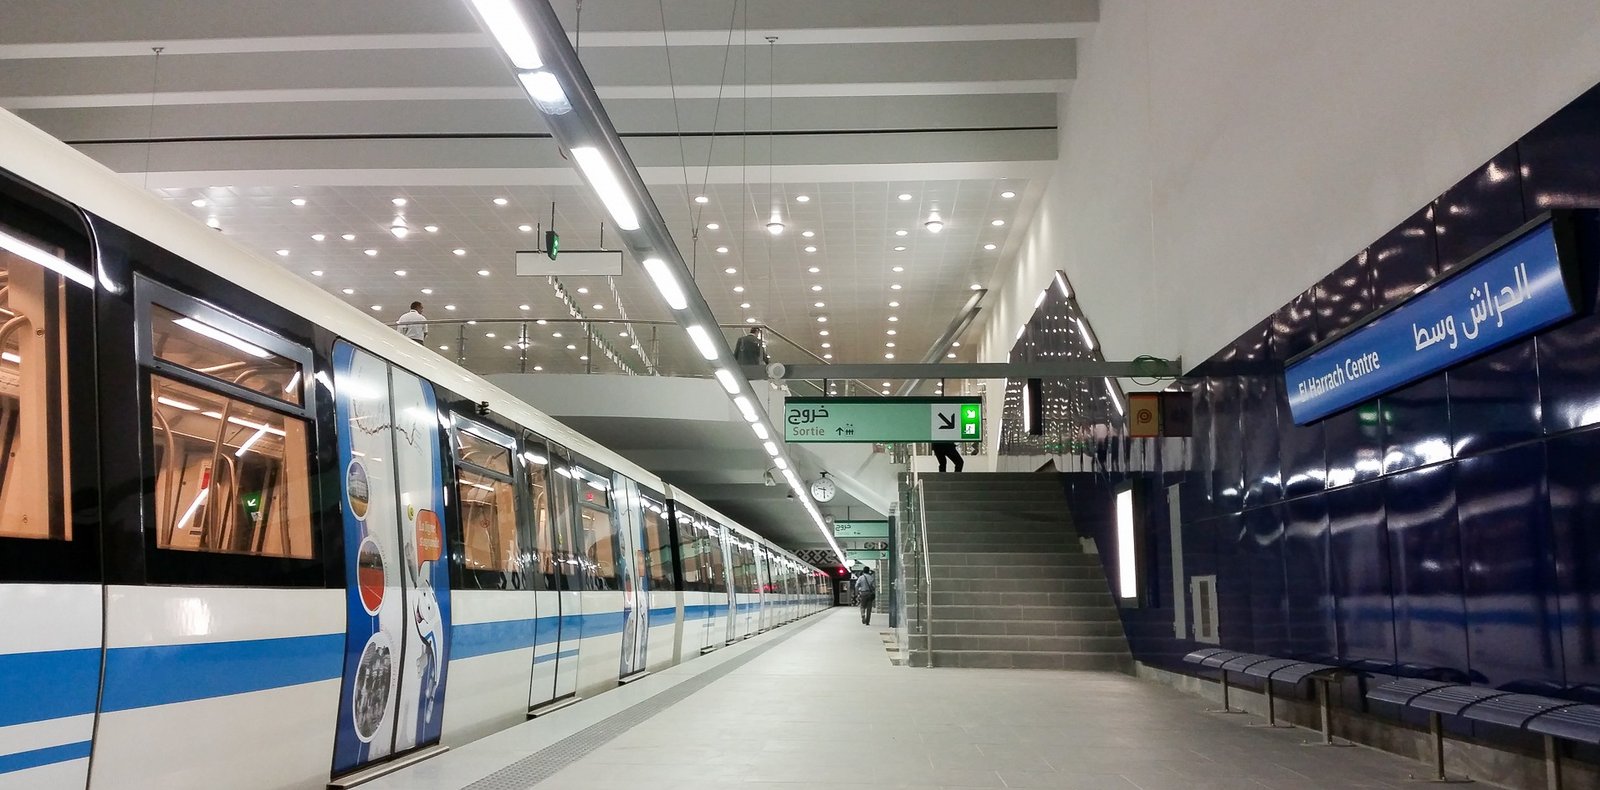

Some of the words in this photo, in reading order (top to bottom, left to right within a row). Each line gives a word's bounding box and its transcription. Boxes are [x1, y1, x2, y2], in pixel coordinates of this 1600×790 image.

[1462, 262, 1531, 340] الحراش
[1413, 315, 1458, 351] وسط
[1298, 381, 1308, 403] El
[1308, 363, 1346, 398] Harrach
[1345, 351, 1381, 381] Centre
[788, 405, 829, 425] خروج
[793, 426, 825, 436] Sortie
